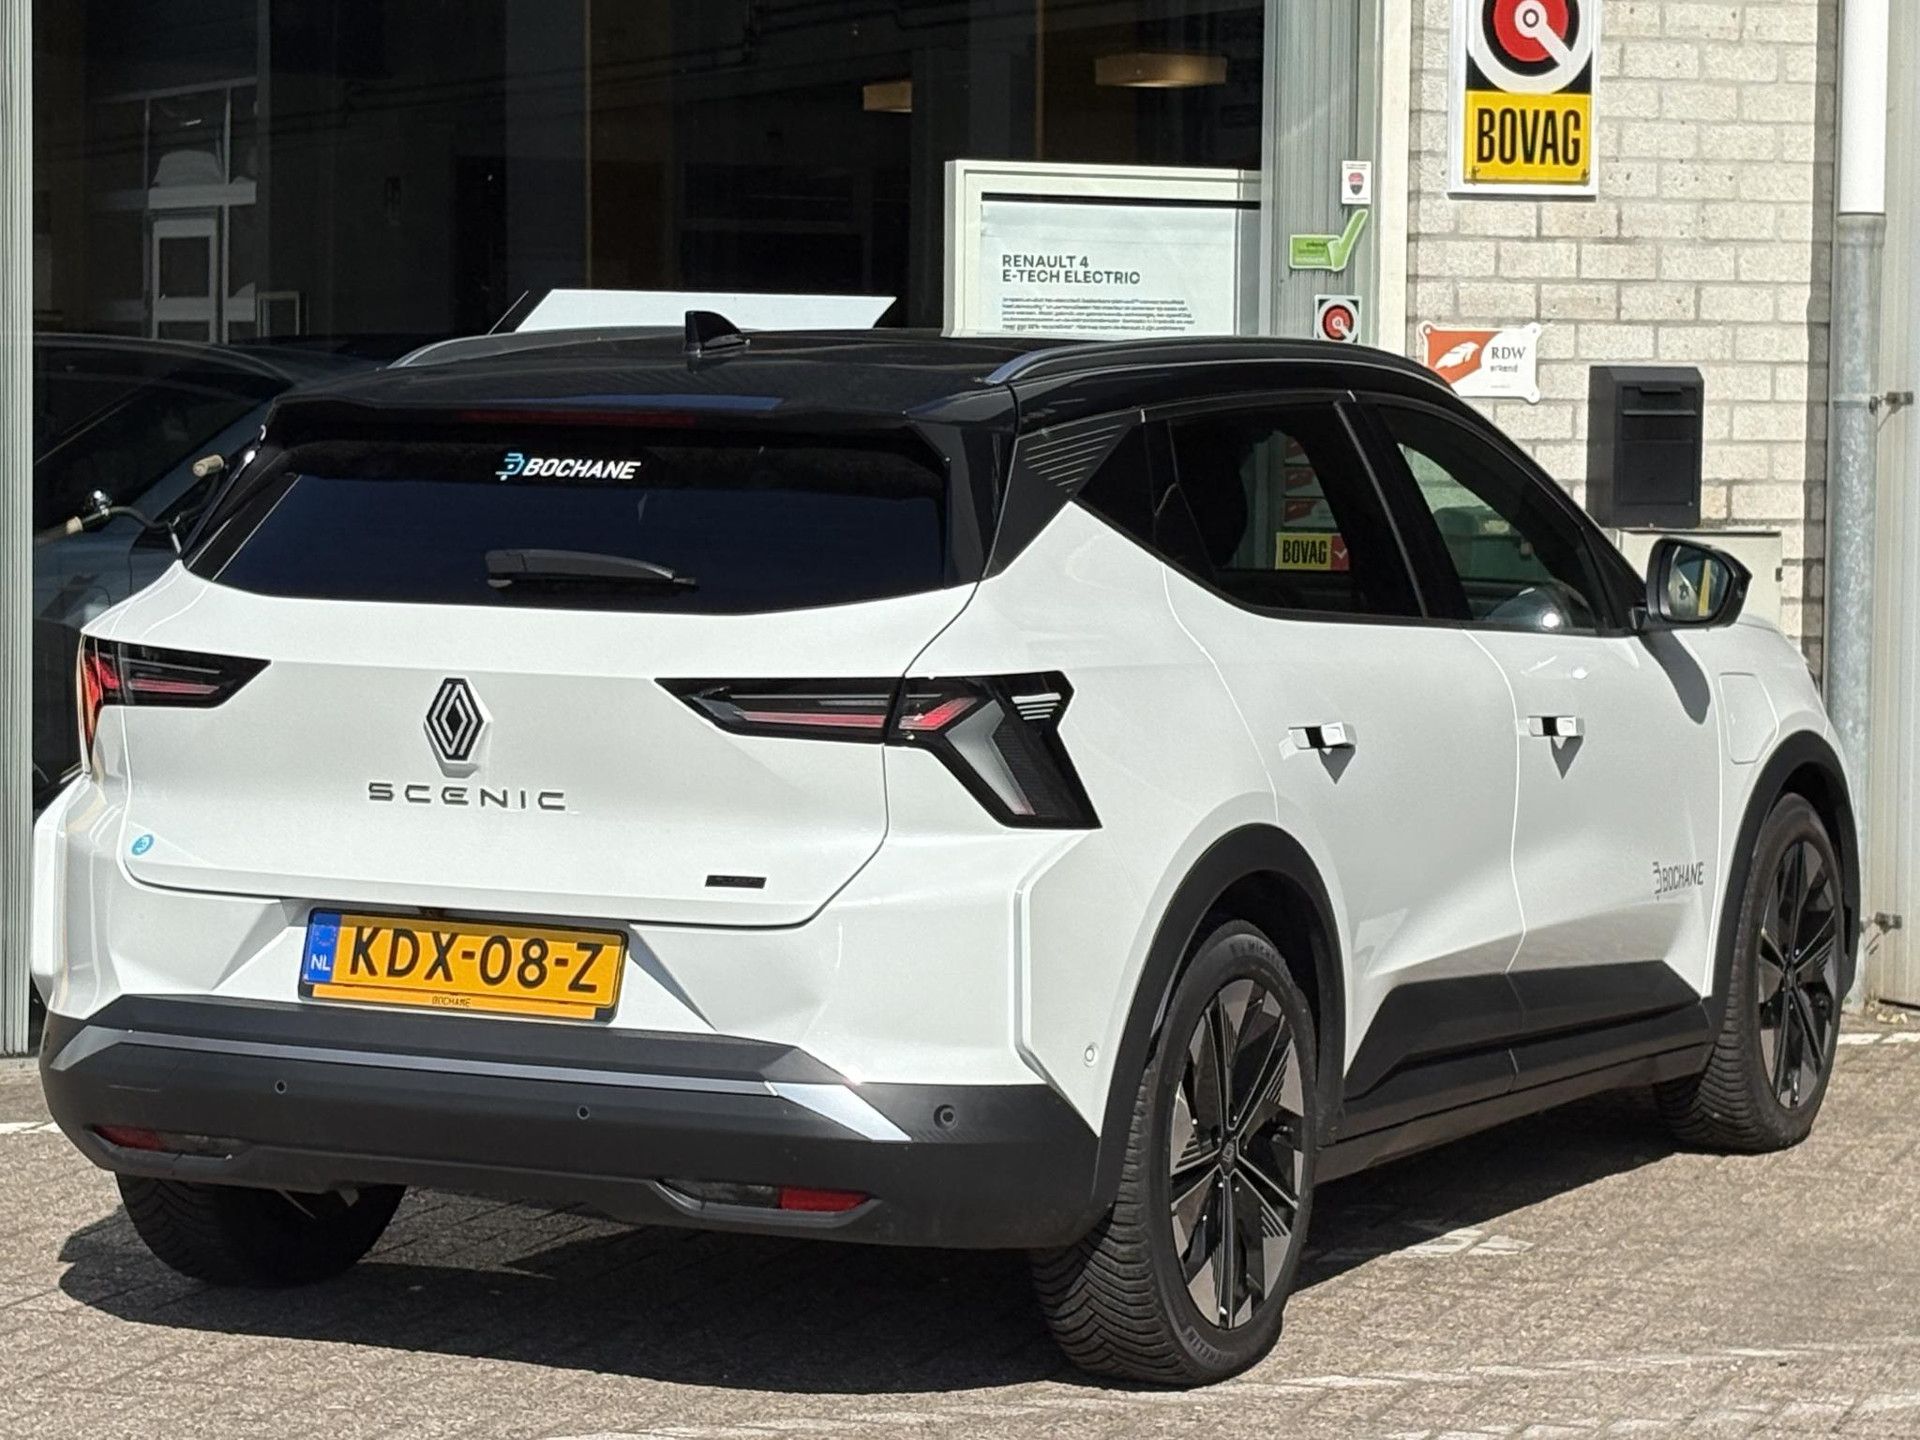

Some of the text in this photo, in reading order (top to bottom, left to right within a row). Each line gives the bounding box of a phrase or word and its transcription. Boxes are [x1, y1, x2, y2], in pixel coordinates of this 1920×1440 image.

[1477, 107, 1581, 166] BOVAG
[1002, 254, 1089, 268] RENAULT 4
[1002, 269, 1141, 284] E-TECH ELECTRIC
[1491, 347, 1526, 360] RDW
[522, 458, 642, 480] BOCHANE
[1282, 540, 1327, 564] BOVAG
[368, 782, 566, 811] SCENIC
[1662, 861, 1704, 893] BOCHANE
[311, 953, 331, 972] NL
[349, 925, 604, 994] KDX-08-Z
